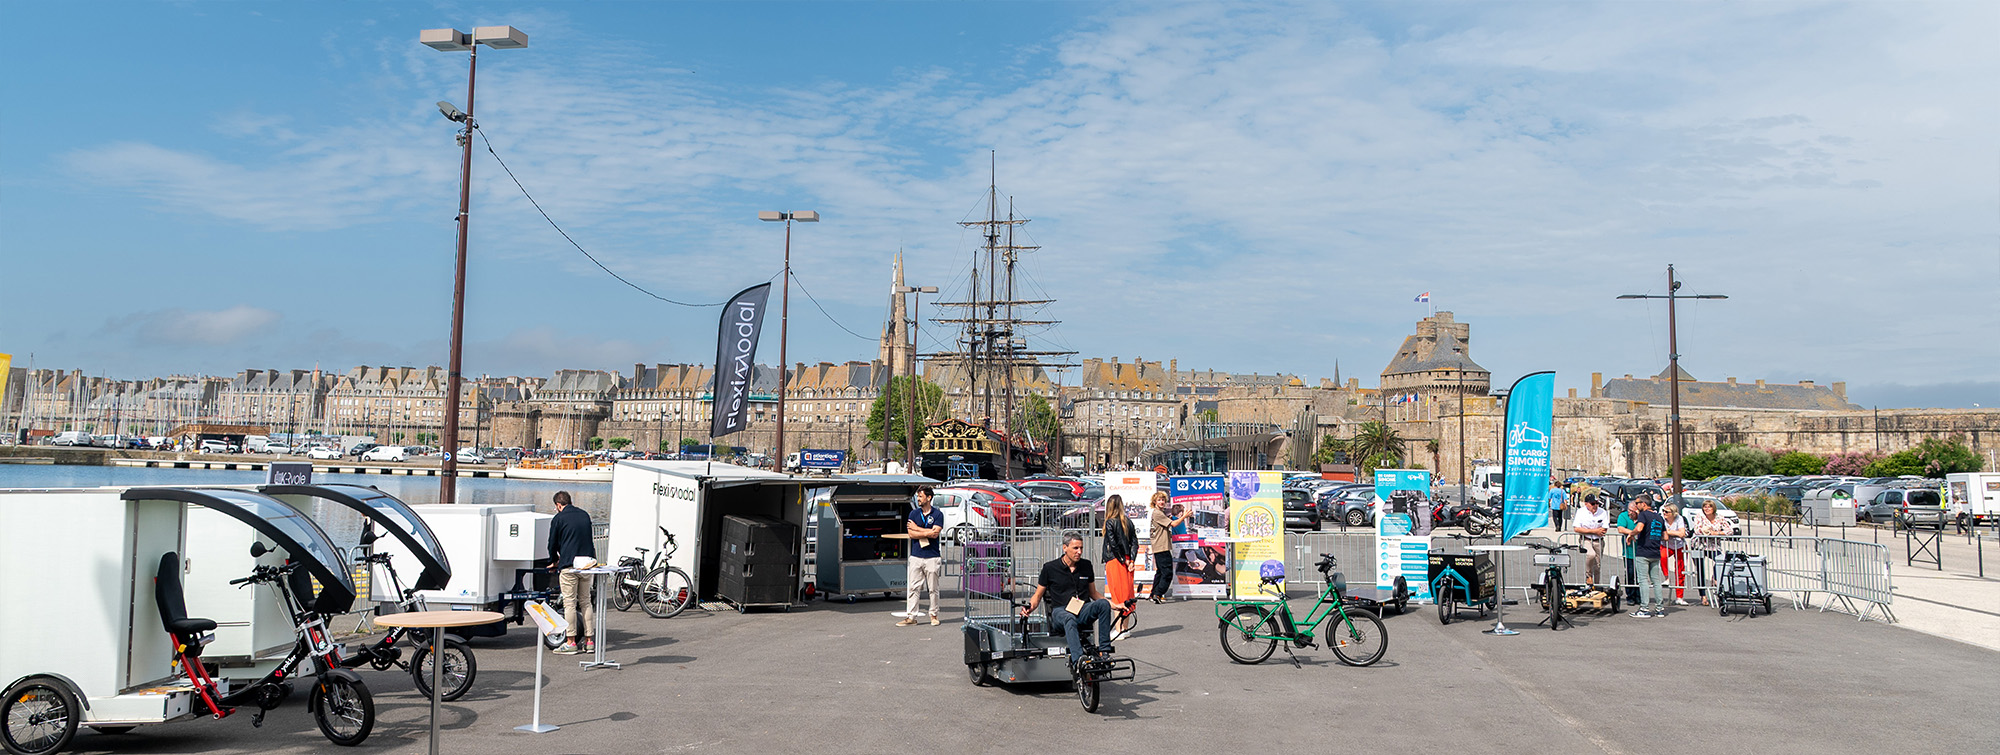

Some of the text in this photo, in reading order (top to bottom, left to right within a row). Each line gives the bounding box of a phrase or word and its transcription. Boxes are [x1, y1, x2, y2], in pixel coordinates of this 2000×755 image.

[1508, 448, 1548, 457] EN CARGO
[1507, 457, 1548, 467] SIMONE
[1191, 480, 1218, 490] CYKE
